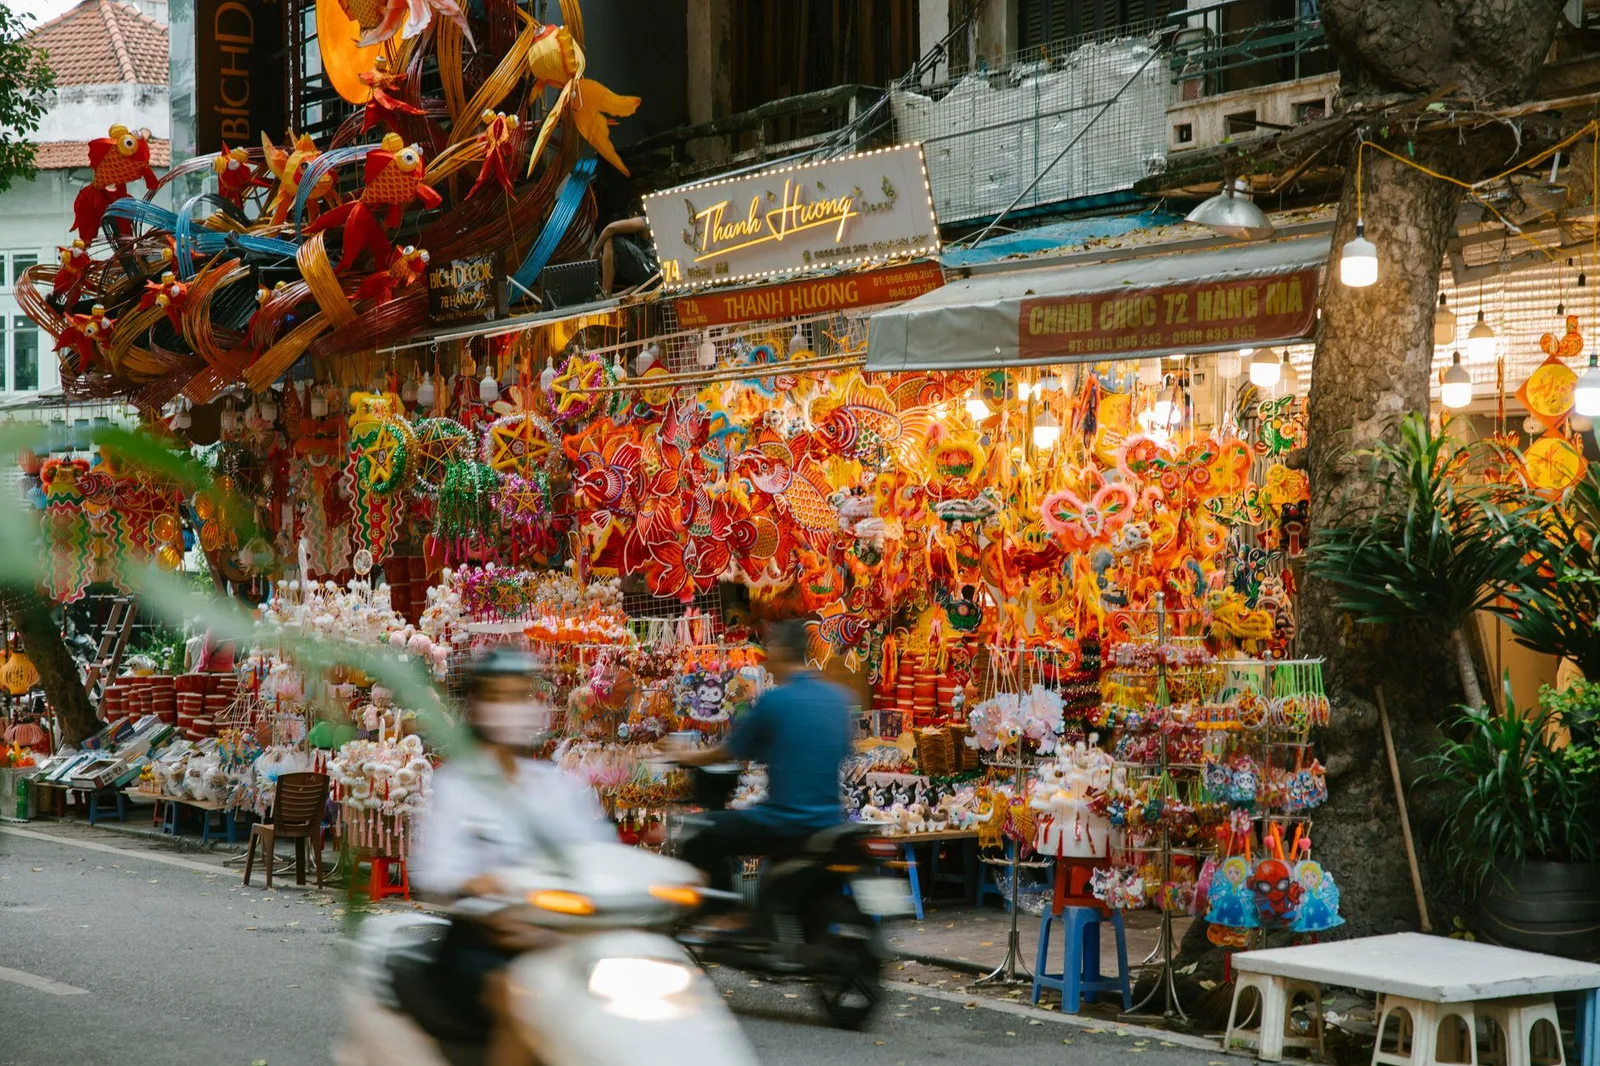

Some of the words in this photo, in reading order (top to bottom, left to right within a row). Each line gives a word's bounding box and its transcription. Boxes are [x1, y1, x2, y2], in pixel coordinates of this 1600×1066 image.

[696, 196, 762, 251] Thanh
[663, 259, 681, 282] 74
[885, 268, 934, 285] 0966.909.205
[681, 300, 699, 316] 74
[723, 289, 784, 320] THANH
[789, 280, 858, 313] HƯƠNG
[1163, 292, 1189, 325] 72
[1197, 285, 1259, 322] HÀNG
[1265, 276, 1304, 316] MÃ
[1087, 336, 1113, 351] 0913
[1141, 332, 1161, 347] 242
[1172, 329, 1202, 344] 0988
